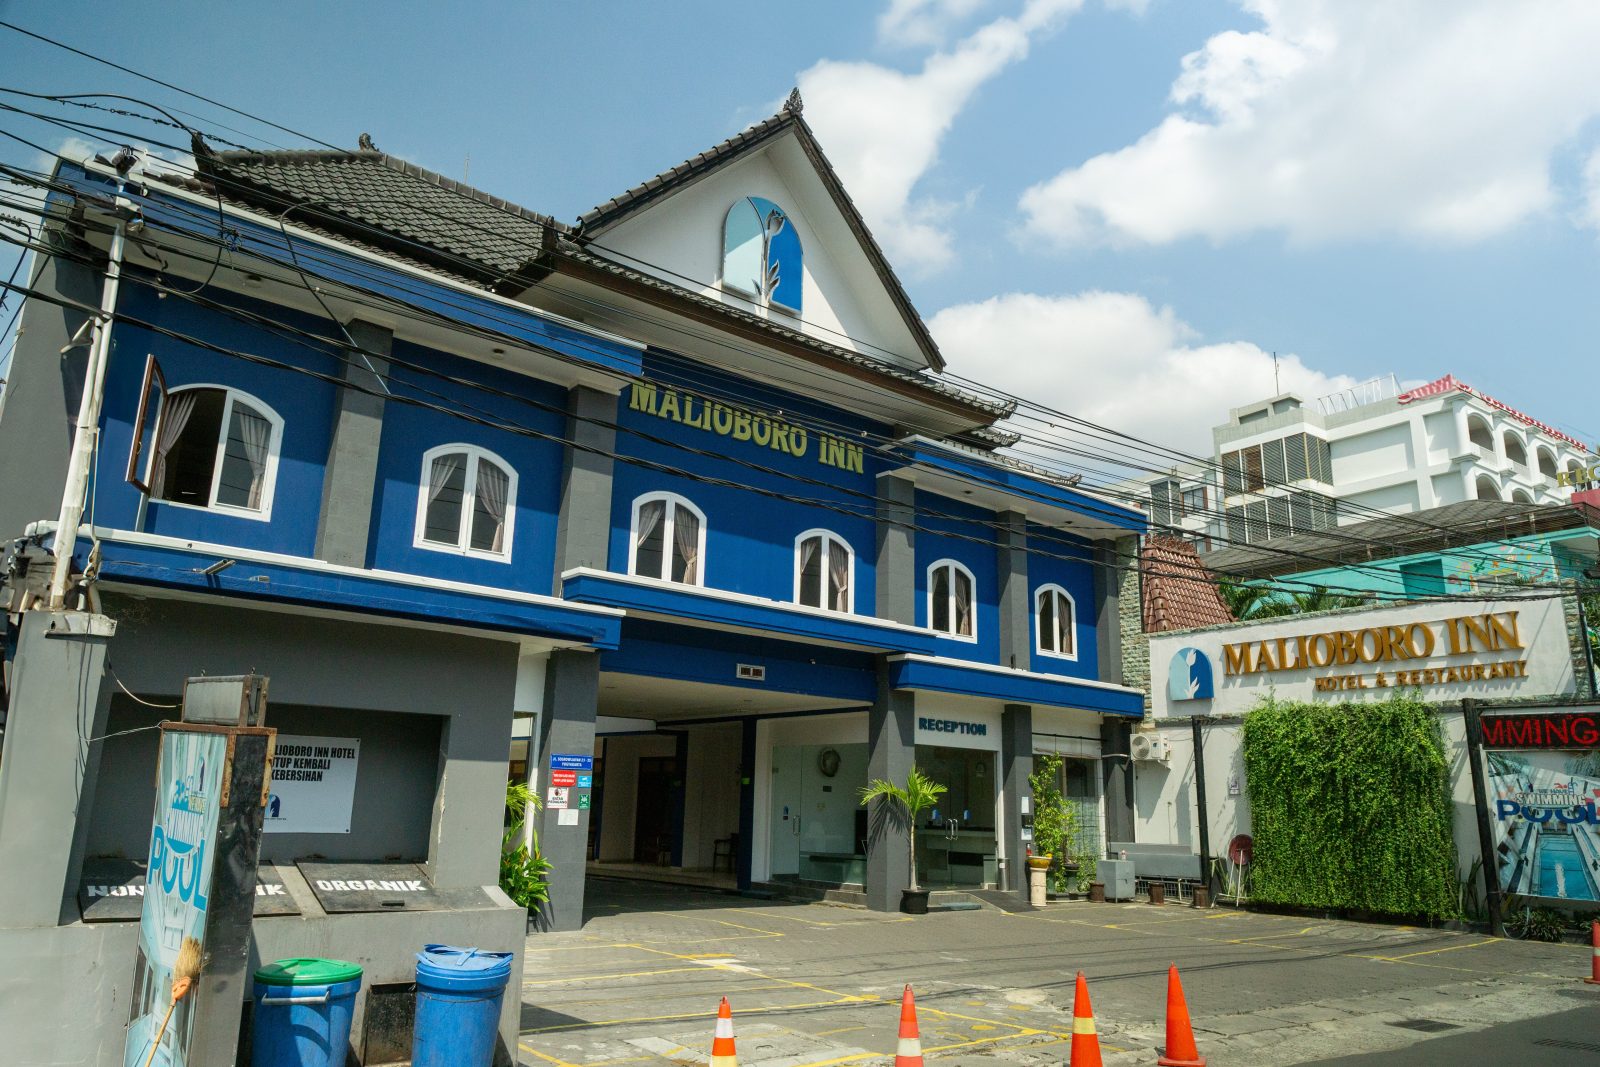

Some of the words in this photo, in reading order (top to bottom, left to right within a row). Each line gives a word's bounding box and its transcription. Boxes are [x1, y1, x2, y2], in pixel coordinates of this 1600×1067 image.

[629, 381, 808, 457] MALIOBORO
[818, 430, 864, 475] INN
[1221, 622, 1435, 676] MALIOBORO
[1446, 610, 1526, 656] INN
[1314, 673, 1368, 692] HOTEL
[1375, 672, 1386, 688] &
[1396, 659, 1529, 687] RESTAURANT
[918, 717, 987, 736] RECEPTION
[274, 744, 313, 757] LIOBORO
[313, 746, 330, 758] INN
[330, 747, 356, 759] HOTEL
[272, 757, 292, 768] TUP
[293, 758, 331, 770] KEMBALI
[1515, 792, 1586, 806] SWIMMING
[1496, 799, 1600, 825] POOL
[147, 824, 208, 912] POOL
[87, 884, 145, 898] NON
[315, 879, 427, 893] ORGANIK
